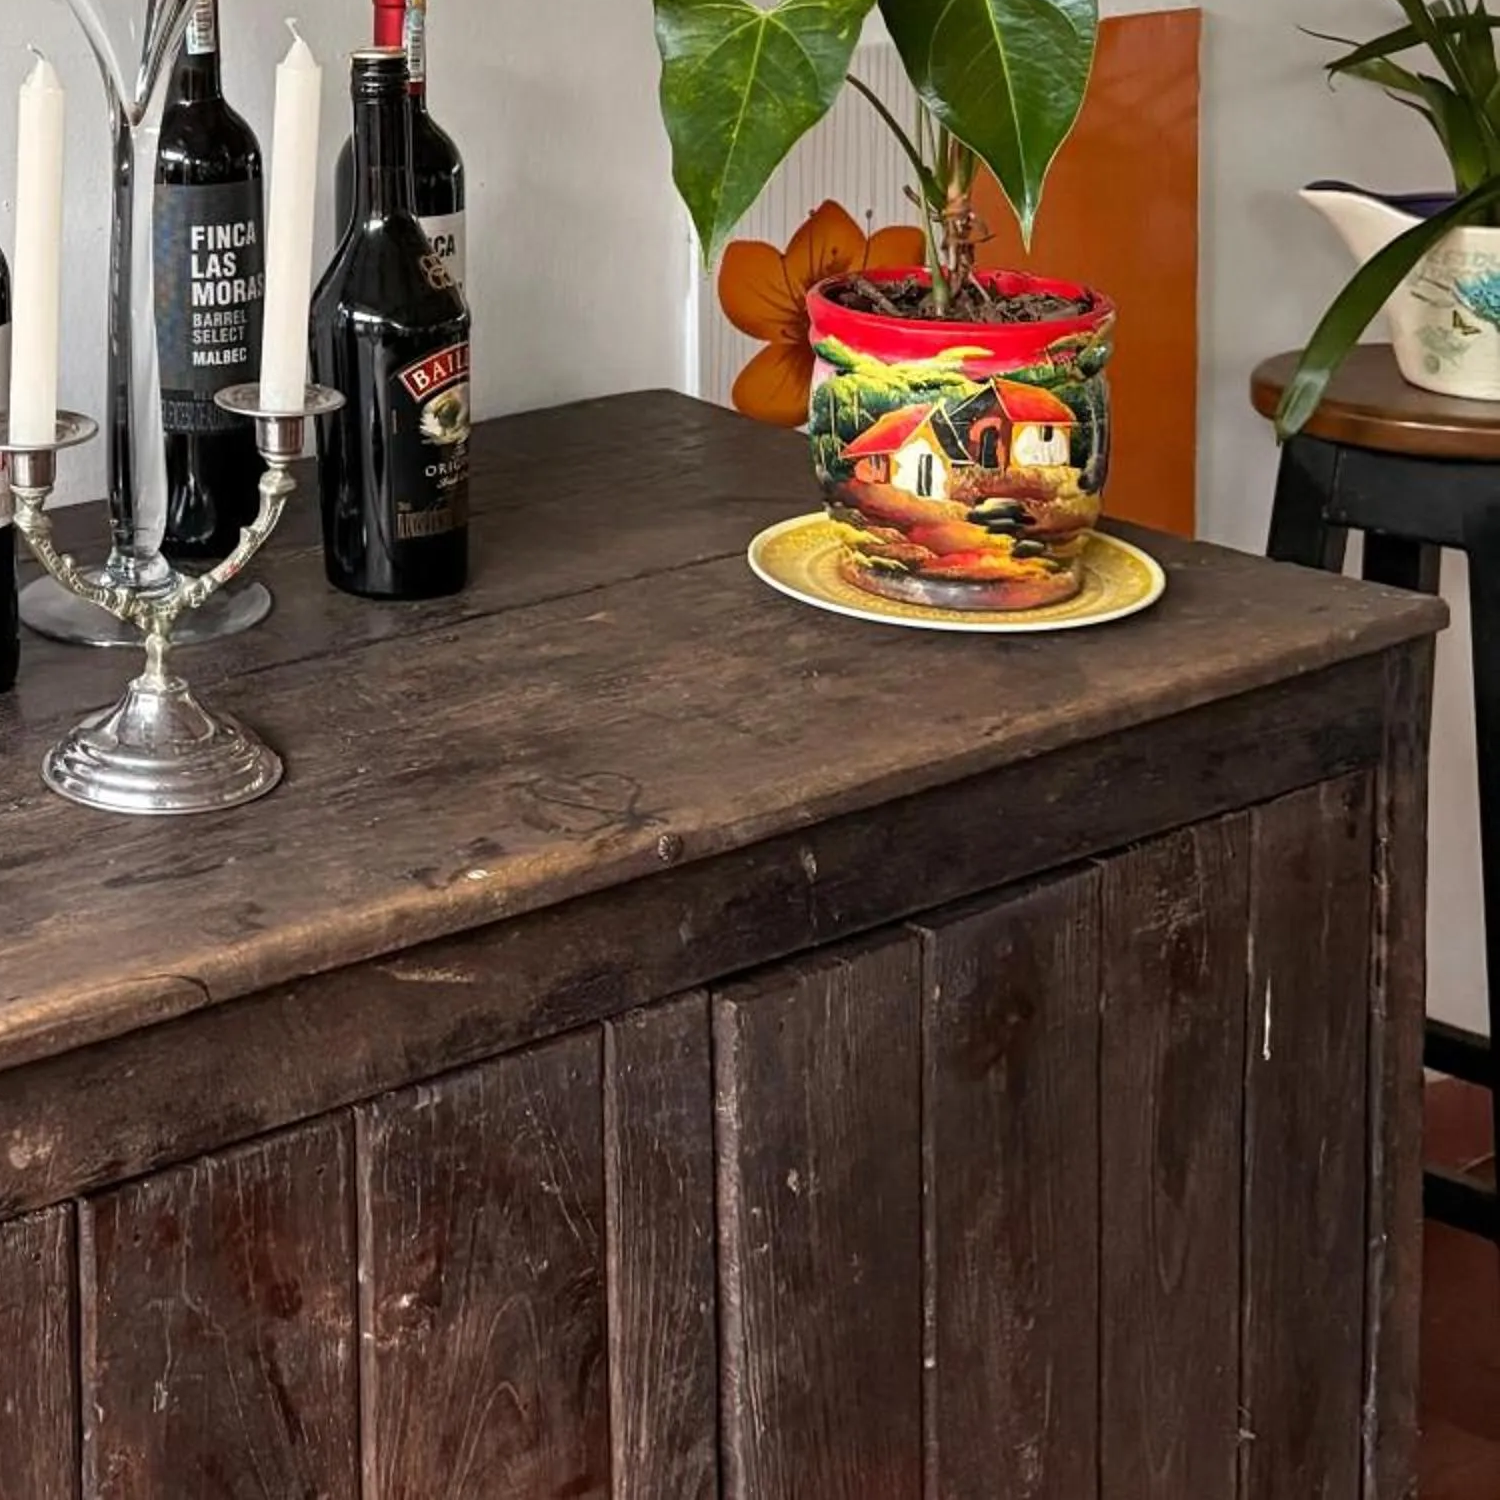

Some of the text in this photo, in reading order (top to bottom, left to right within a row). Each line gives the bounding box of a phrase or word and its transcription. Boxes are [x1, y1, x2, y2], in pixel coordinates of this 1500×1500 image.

[190, 220, 257, 251] FINCA
[190, 251, 237, 279] LAS
[192, 309, 248, 329] BARREL
[192, 325, 246, 345] SELECT
[192, 347, 248, 367] MALBEC
